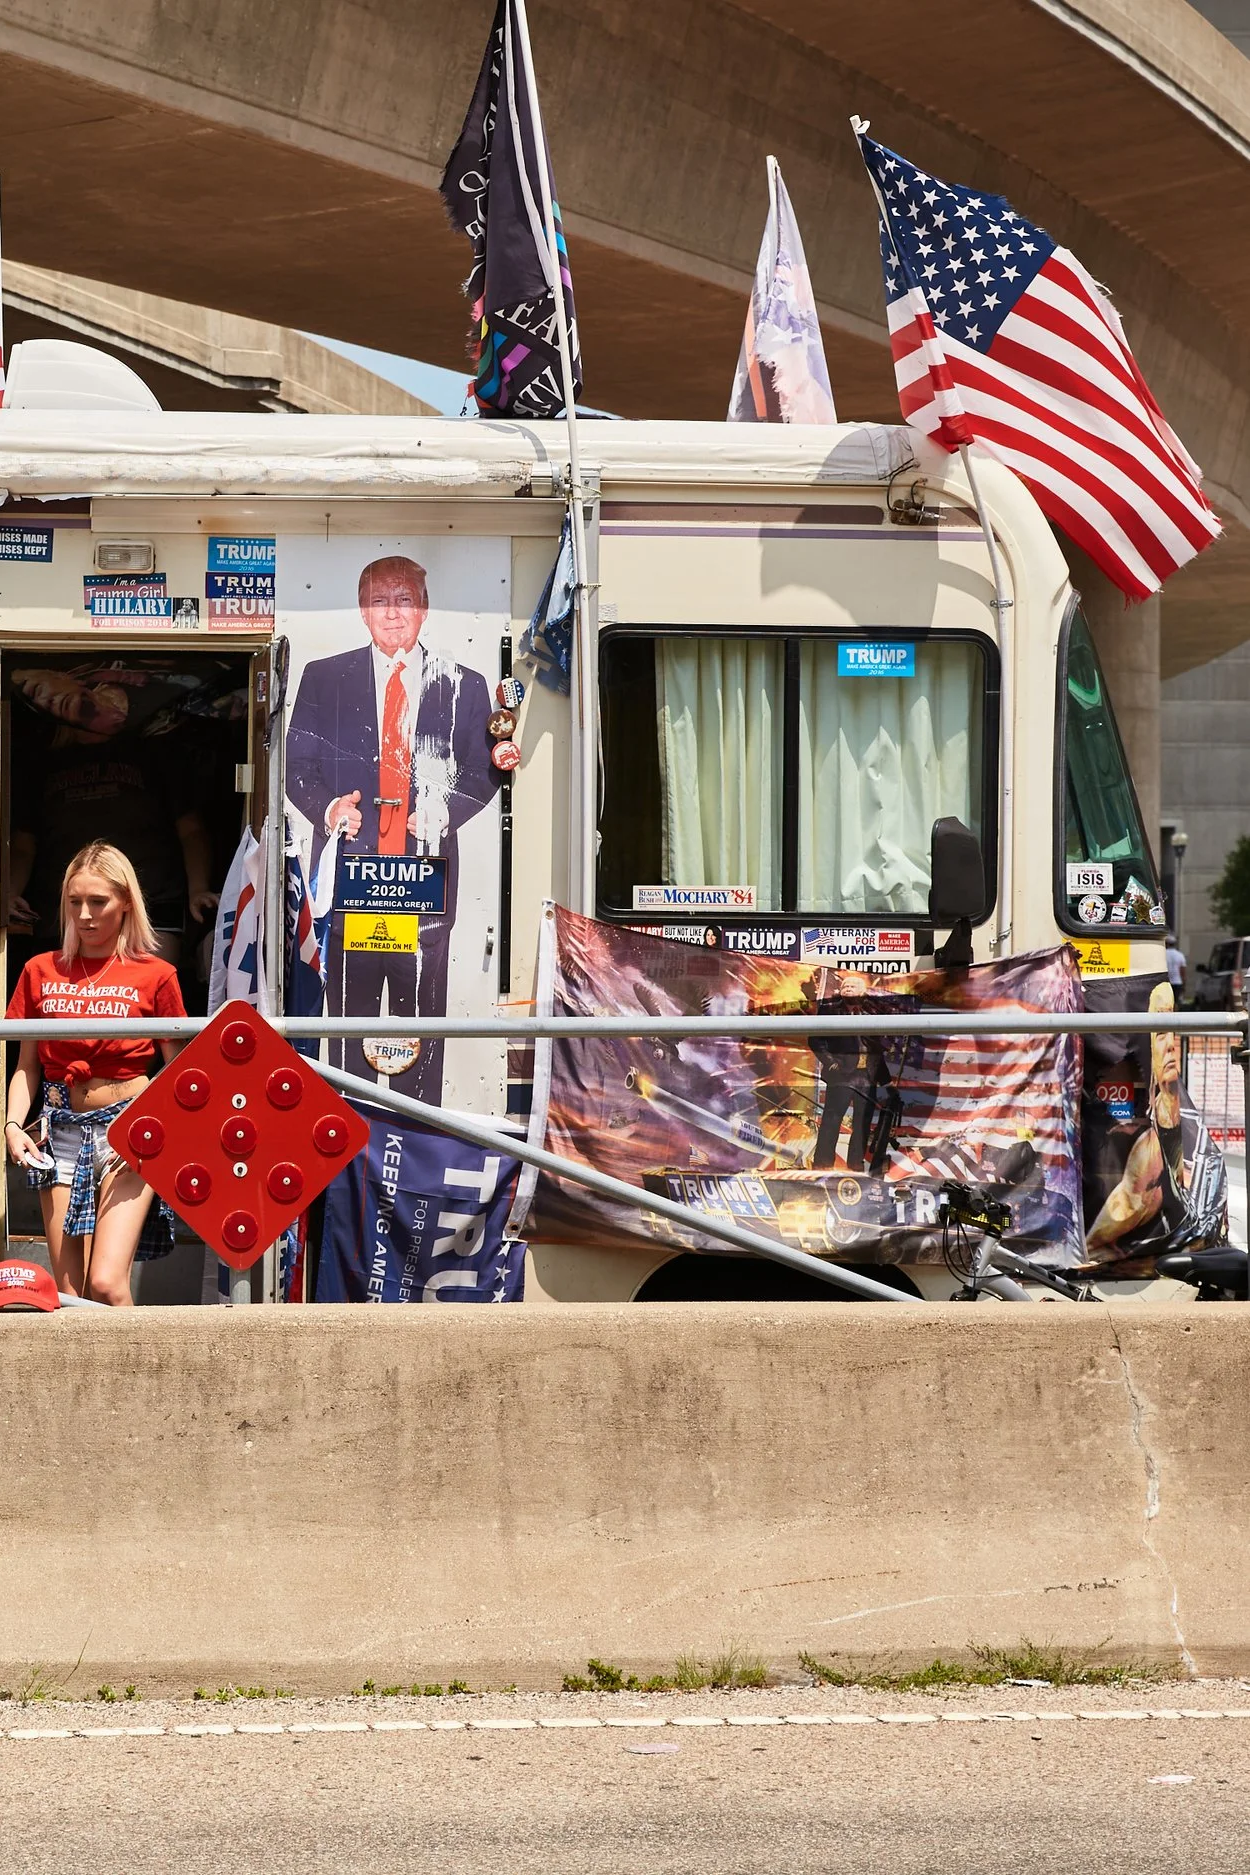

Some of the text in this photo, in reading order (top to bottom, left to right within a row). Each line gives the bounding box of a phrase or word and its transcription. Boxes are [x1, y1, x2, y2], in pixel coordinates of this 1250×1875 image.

[23, 533, 48, 544] MADE
[24, 546, 47, 556] KEPT
[216, 544, 276, 560] TRUMP
[114, 577, 137, 586] I'm a
[214, 576, 276, 588] TRUM
[86, 585, 164, 599] Trump Girl
[226, 587, 274, 595] PENCE
[94, 598, 169, 615] HILLARY
[94, 618, 111, 626] FOR
[113, 618, 144, 626] PRISON
[846, 648, 907, 664] TRUMP
[344, 861, 434, 882] TRUMP
[1077, 873, 1104, 885] ISIS
[366, 885, 412, 897] -2020-
[663, 887, 753, 904] MOCHARY '84
[343, 899, 365, 907] KEEP
[404, 901, 434, 909] GREAT!
[665, 927, 676, 936] BUT
[677, 928, 689, 936] NOT
[689, 928, 702, 937] LIKE
[821, 928, 876, 937] VETERANS
[725, 931, 797, 949] TRUMP
[855, 937, 876, 945] FOR
[816, 945, 876, 955] TRUMP
[838, 960, 908, 974] AMERICA
[1086, 966, 1105, 974] TREAD
[41, 982, 140, 1003] MAKE AMERICA
[42, 999, 131, 1018] GREAT AGAIN
[375, 1045, 414, 1059] TRUMP
[374, 1132, 404, 1236] KEEPING
[668, 1178, 765, 1202] TRUMP
[413, 1198, 428, 1231] FOR
